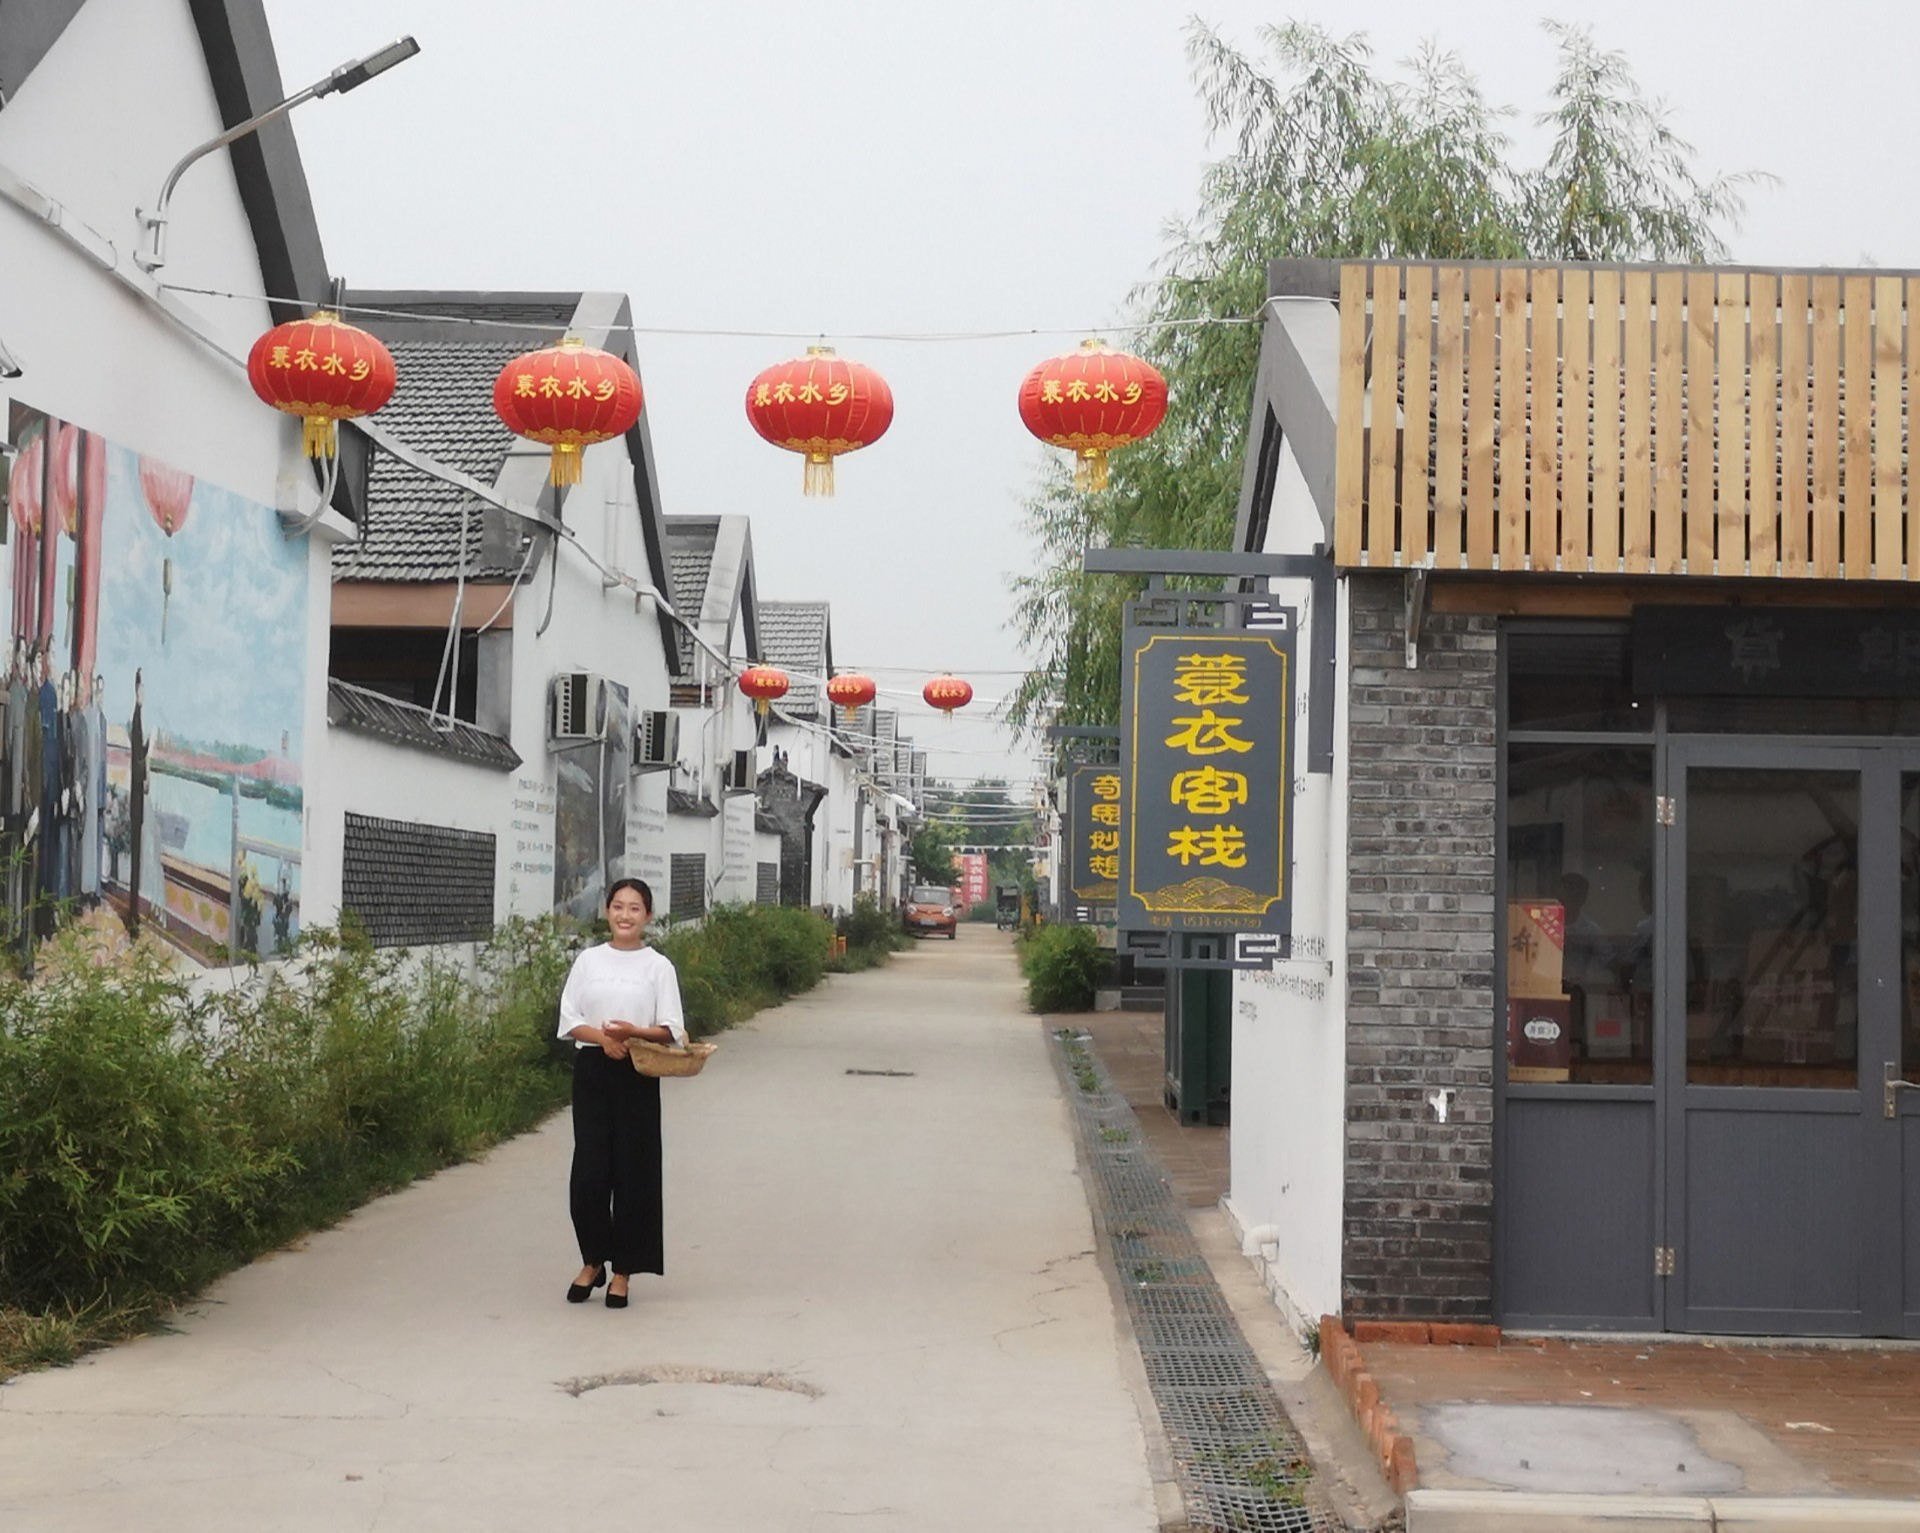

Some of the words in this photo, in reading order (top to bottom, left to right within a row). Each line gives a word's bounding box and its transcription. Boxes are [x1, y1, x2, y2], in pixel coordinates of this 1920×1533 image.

[268, 345, 371, 381] 蓑衣水乡
[514, 374, 616, 401] 蓑衣水乡
[754, 380, 850, 406] 蓑衣水乡
[1040, 379, 1143, 406] 蓑衣水乡
[1165, 652, 1255, 869] 蓑衣客栈
